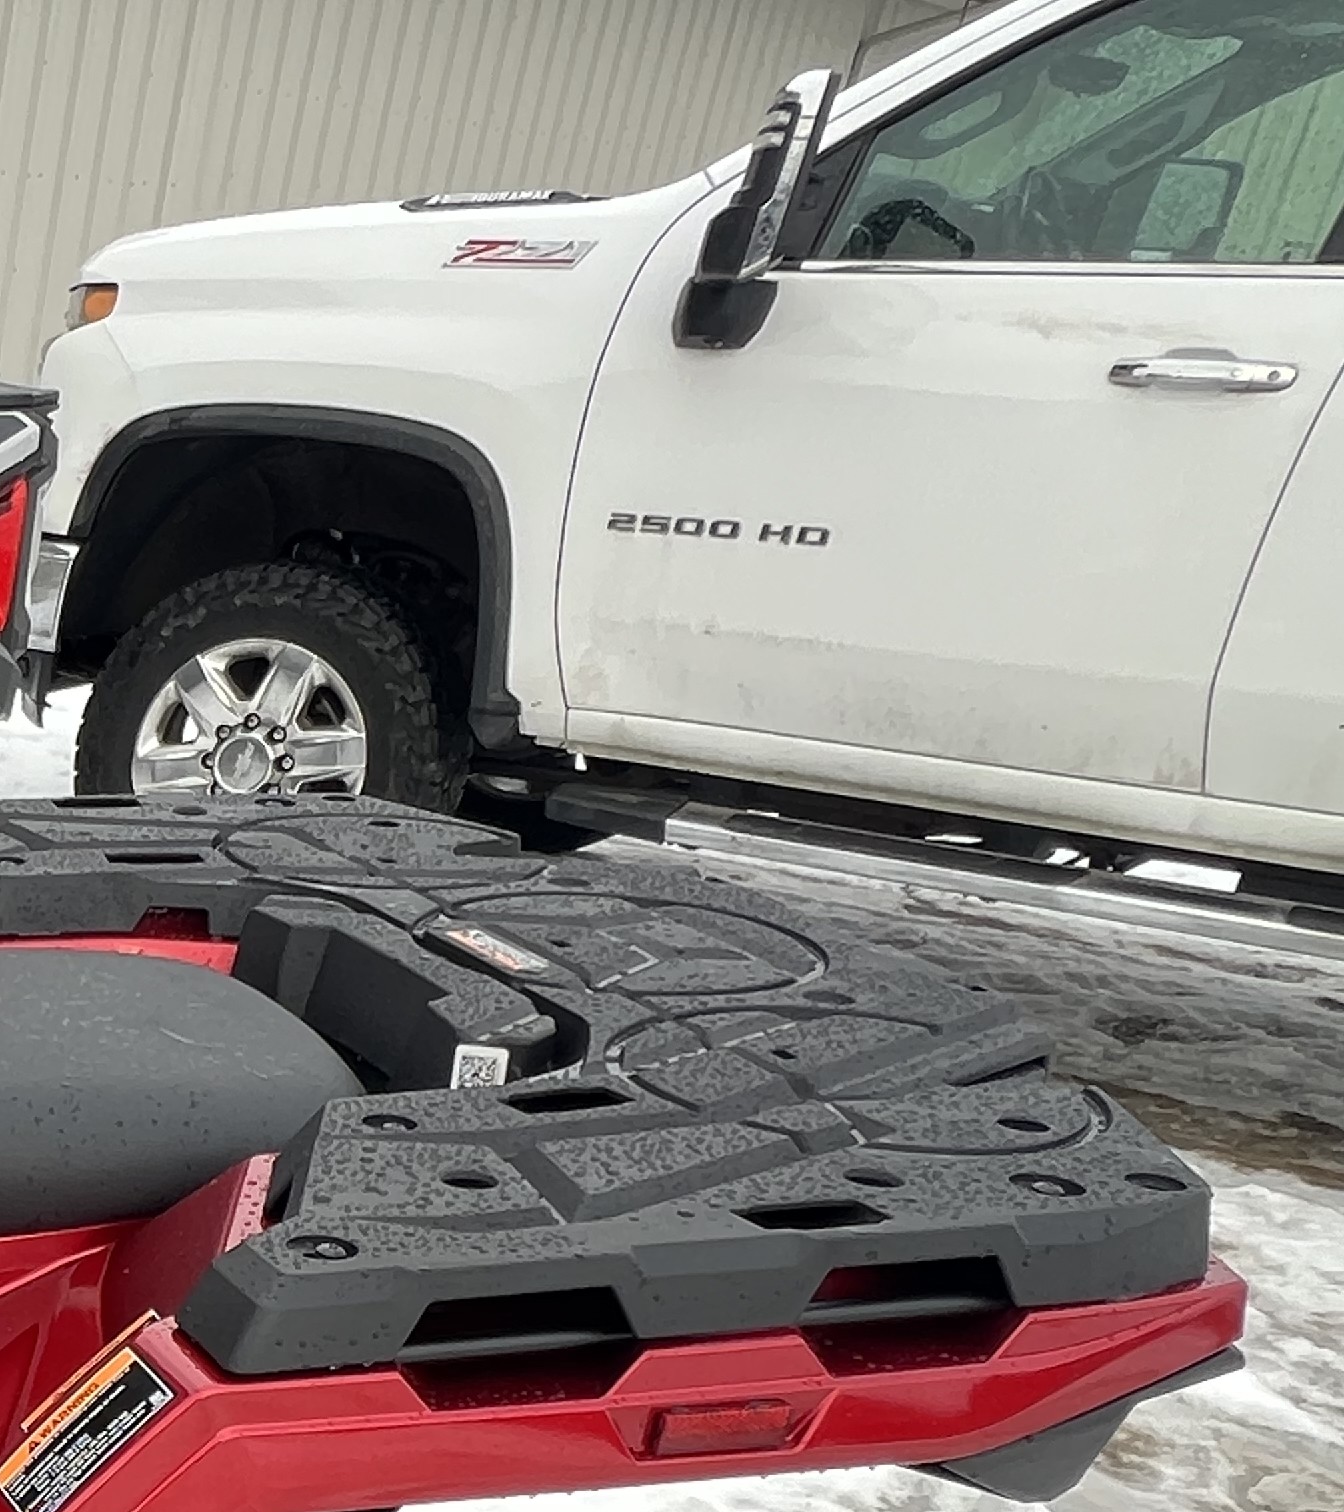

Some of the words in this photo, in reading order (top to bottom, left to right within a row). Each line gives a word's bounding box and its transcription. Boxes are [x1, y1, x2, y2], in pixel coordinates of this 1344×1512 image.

[607, 512, 740, 539] 2500
[758, 522, 831, 546] HD
[37, 1382, 100, 1440] WARNING
